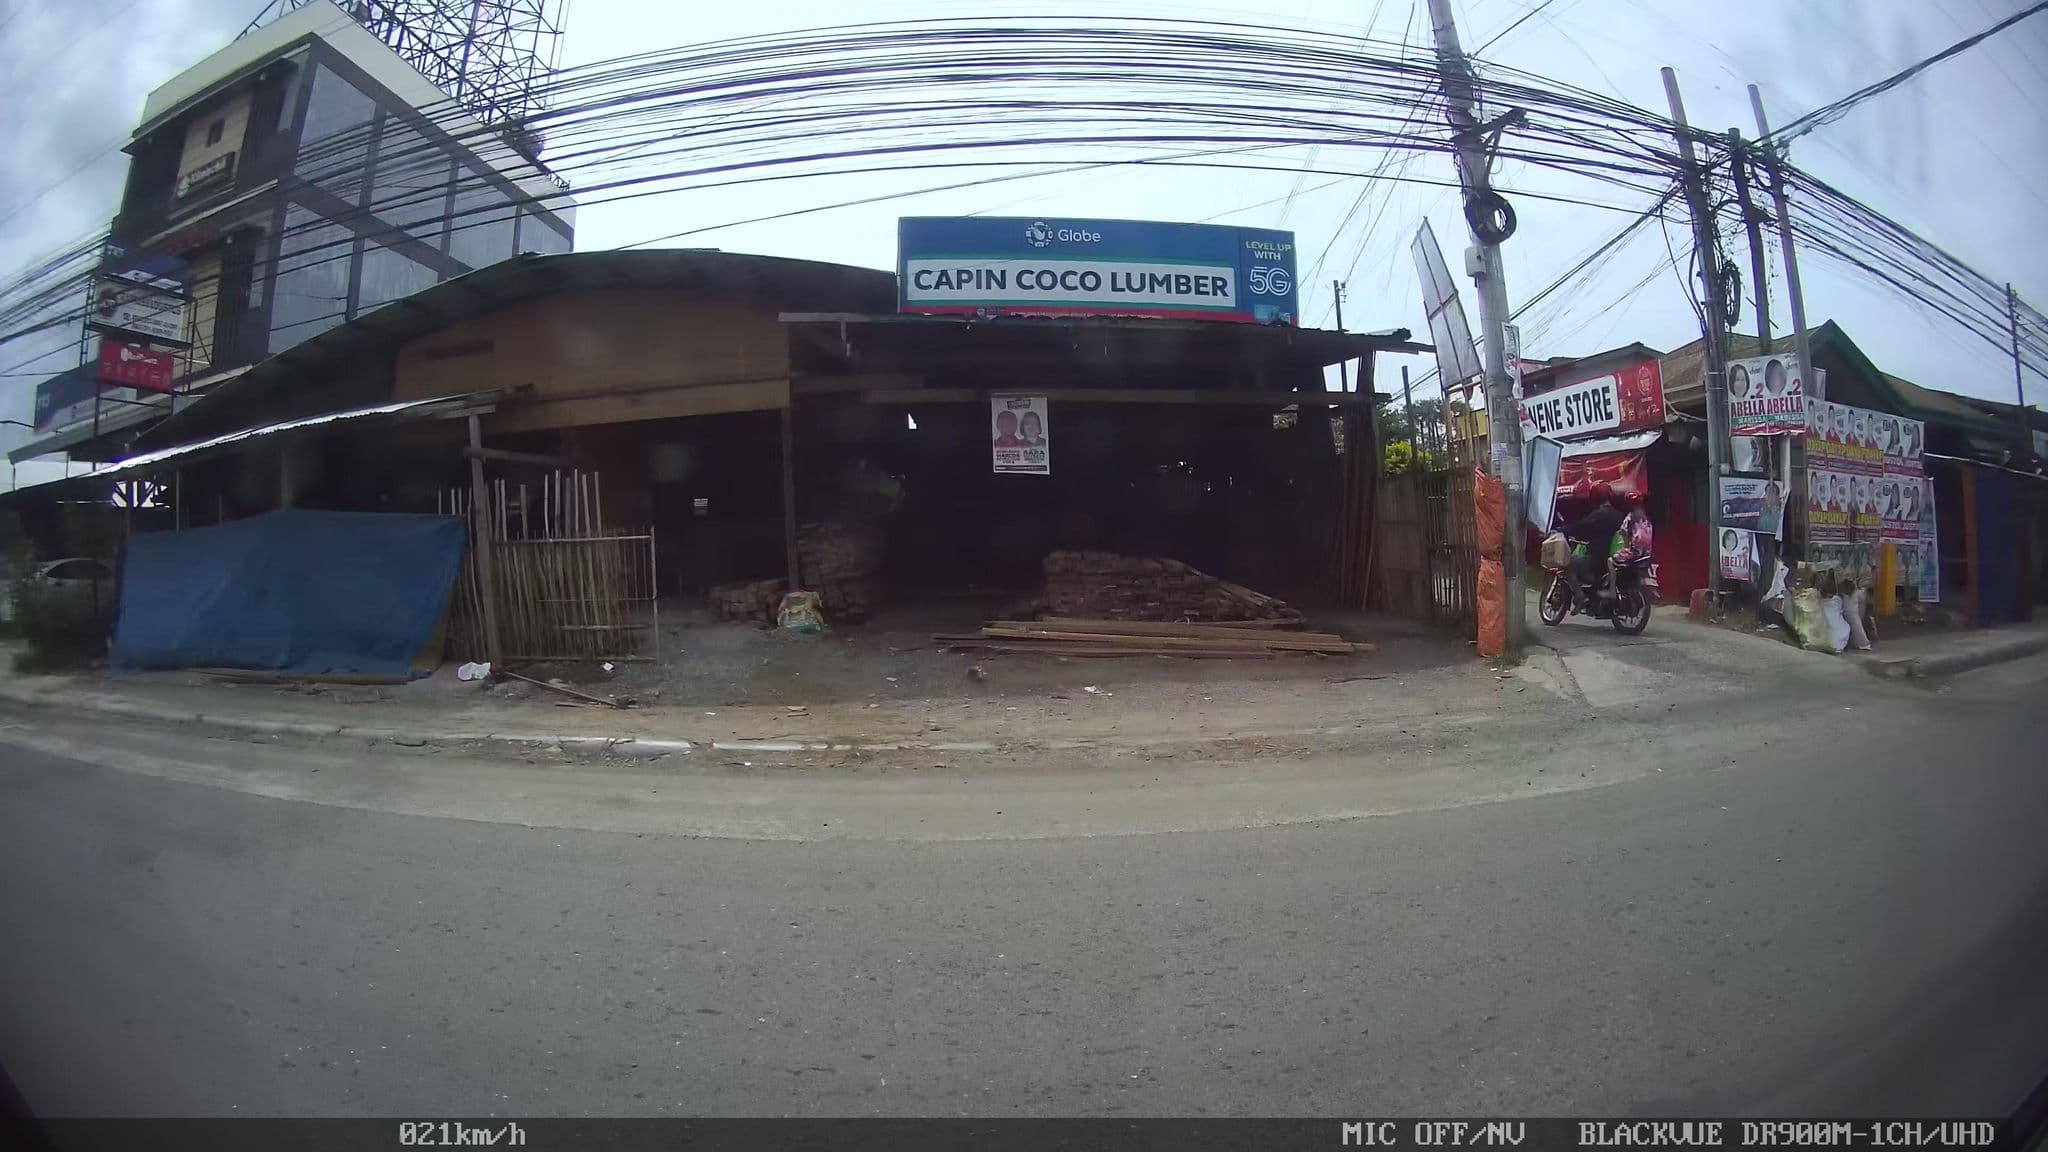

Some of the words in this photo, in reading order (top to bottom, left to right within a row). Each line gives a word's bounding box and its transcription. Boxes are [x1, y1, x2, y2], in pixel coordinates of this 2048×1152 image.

[1058, 229, 1101, 243] Globe
[1246, 240, 1276, 251] LEVEL
[1277, 243, 1291, 252] UP
[1254, 250, 1281, 261] WITH
[914, 268, 1007, 291] CAPIN
[1015, 269, 1102, 292] COCO
[1110, 271, 1229, 297] LUMBER
[1250, 265, 1291, 295] 5G
[1565, 385, 1613, 428] STORE
[1731, 399, 1765, 418] ABELLA
[1767, 397, 1803, 415] ABELLA
